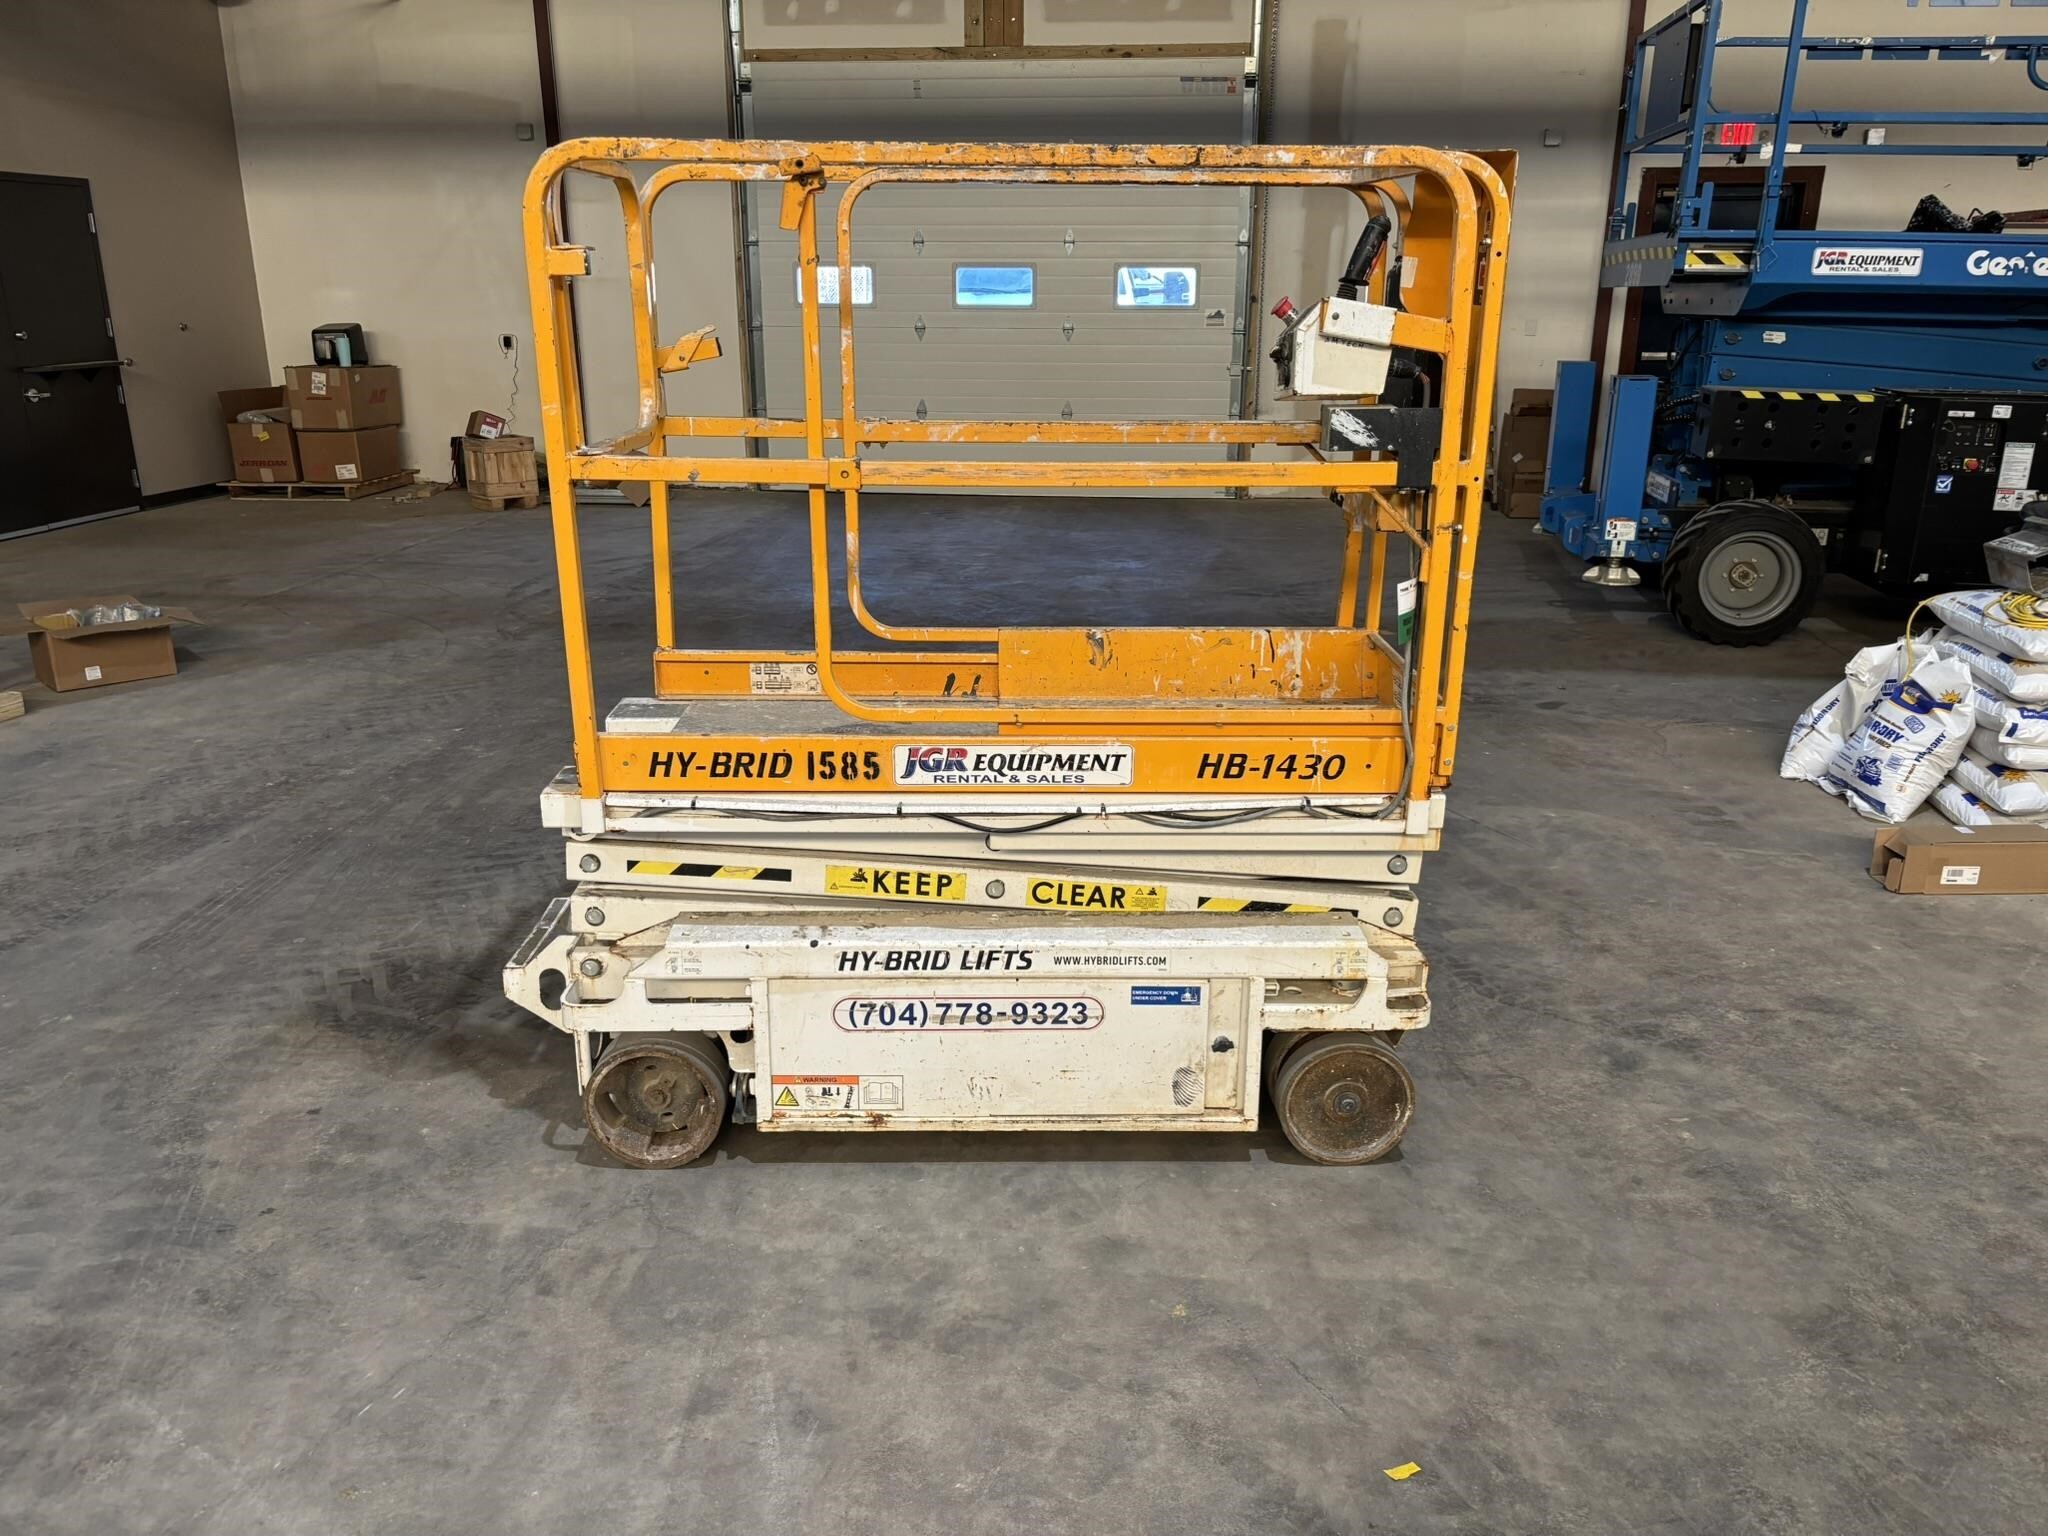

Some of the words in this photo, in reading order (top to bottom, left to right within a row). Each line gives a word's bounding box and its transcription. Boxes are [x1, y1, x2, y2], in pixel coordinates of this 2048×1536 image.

[1720, 123, 1757, 145] EXIT
[1815, 251, 1848, 269] JGR
[1849, 255, 1919, 267] EQUIPMENT
[648, 751, 793, 778] HY-BRID
[807, 751, 881, 780] 1585
[900, 747, 969, 779] JGR
[973, 753, 1127, 777] EQUIPMENT
[1196, 753, 1346, 780] HB-1430
[933, 774, 998, 784] RENTAL
[1008, 774, 1020, 784] &
[1028, 774, 1085, 784] SALES
[873, 869, 953, 897] KEEP
[1031, 881, 1126, 908] CLEAR
[838, 950, 950, 971] HY-BRID
[960, 950, 1033, 970] LIFTS
[1053, 956, 1167, 965] WWW.HYBRIDLIFTS.COM
[848, 1000, 929, 1028] (704)
[935, 1002, 1089, 1025] 778-9323
